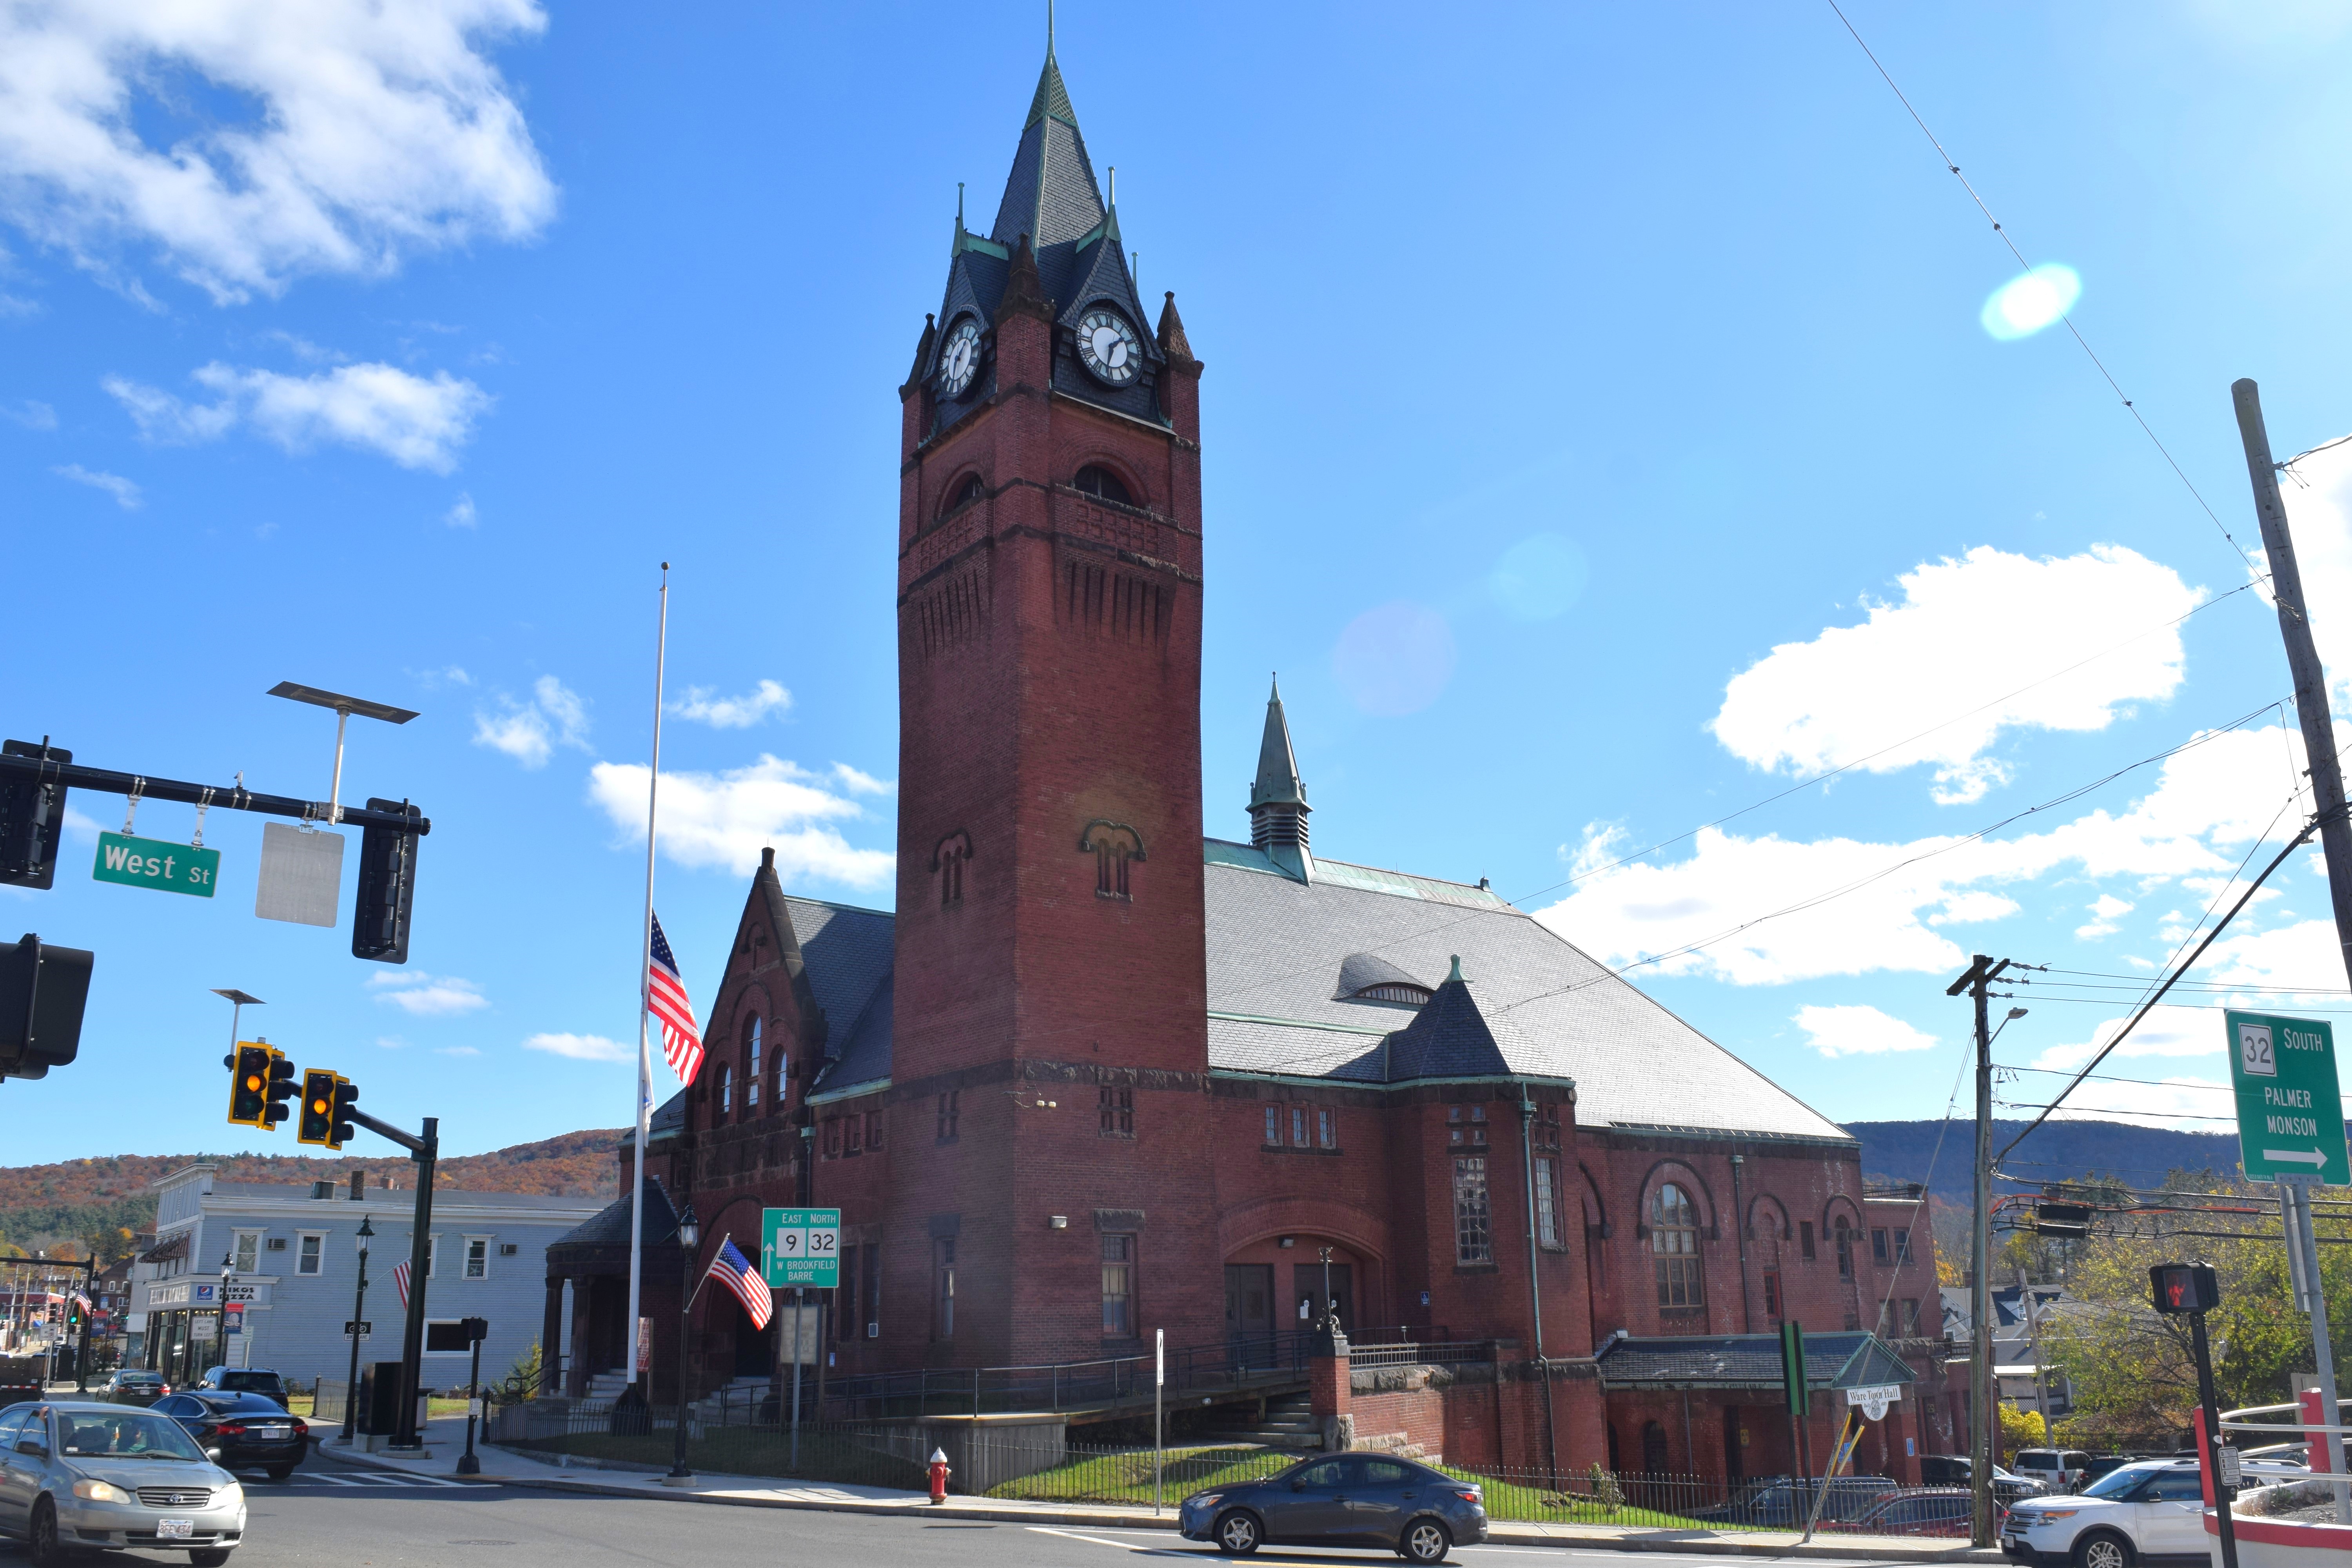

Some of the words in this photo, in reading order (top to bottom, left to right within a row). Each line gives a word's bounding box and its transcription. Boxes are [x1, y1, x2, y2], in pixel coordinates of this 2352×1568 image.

[105, 845, 176, 878] West
[189, 867, 210, 884] St
[2245, 1035, 2271, 1063] 32
[2284, 1028, 2323, 1051] SOUTH
[2265, 1087, 2312, 1108] PALMER
[2267, 1115, 2317, 1136] MONSON
[782, 1213, 802, 1223] EAST
[810, 1213, 836, 1223] NORTH
[786, 1234, 797, 1251] 9
[811, 1234, 834, 1250] 32
[777, 1261, 783, 1270] W
[787, 1260, 835, 1270] BROOKFIELD
[788, 1272, 813, 1280] BARRE
[1850, 1392, 1866, 1401] Ware
[1867, 1390, 1883, 1400] Town
[1884, 1388, 1898, 1398] Hall
[159, 1524, 175, 1534] 8FE
[176, 1525, 191, 1534] 434
